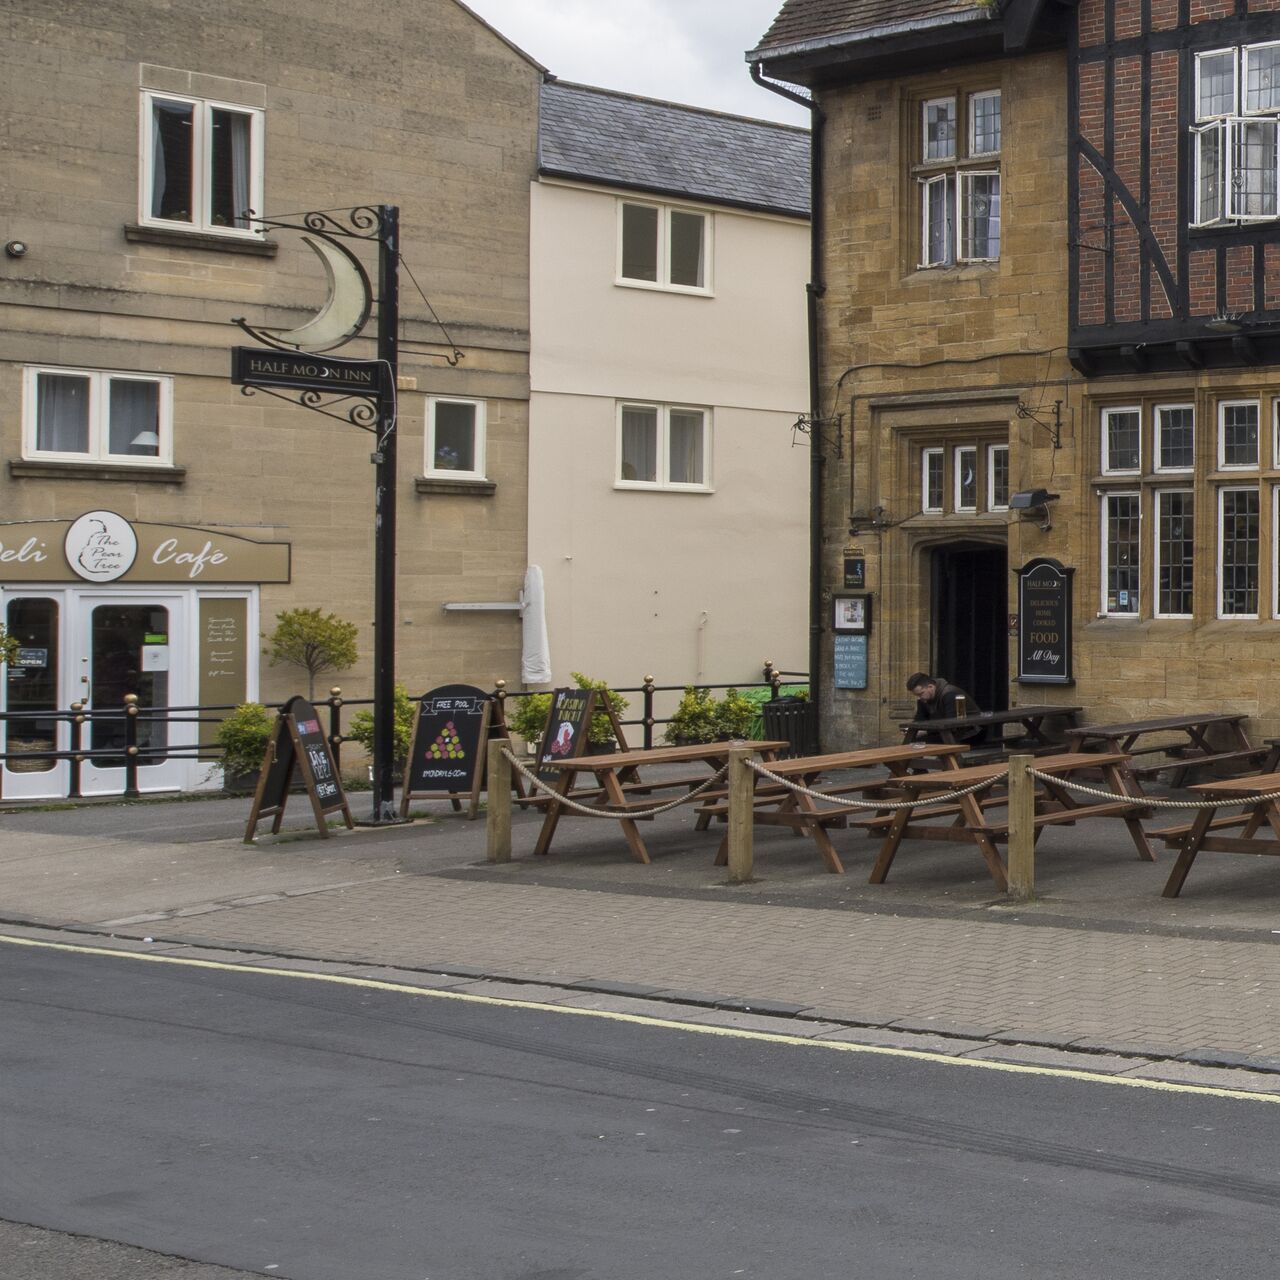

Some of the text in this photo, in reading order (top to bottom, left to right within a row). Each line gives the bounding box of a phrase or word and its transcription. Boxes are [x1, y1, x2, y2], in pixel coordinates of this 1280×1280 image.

[251, 360, 289, 373] HALF
[344, 370, 371, 382] INN
[96, 534, 120, 547] The
[91, 547, 124, 559] Pear
[152, 538, 228, 578] Café
[93, 558, 121, 570] Tree
[1030, 632, 1059, 644] FOOD
[1027, 650, 1060, 664] All Day
[436, 700, 469, 709] FREE POOL
